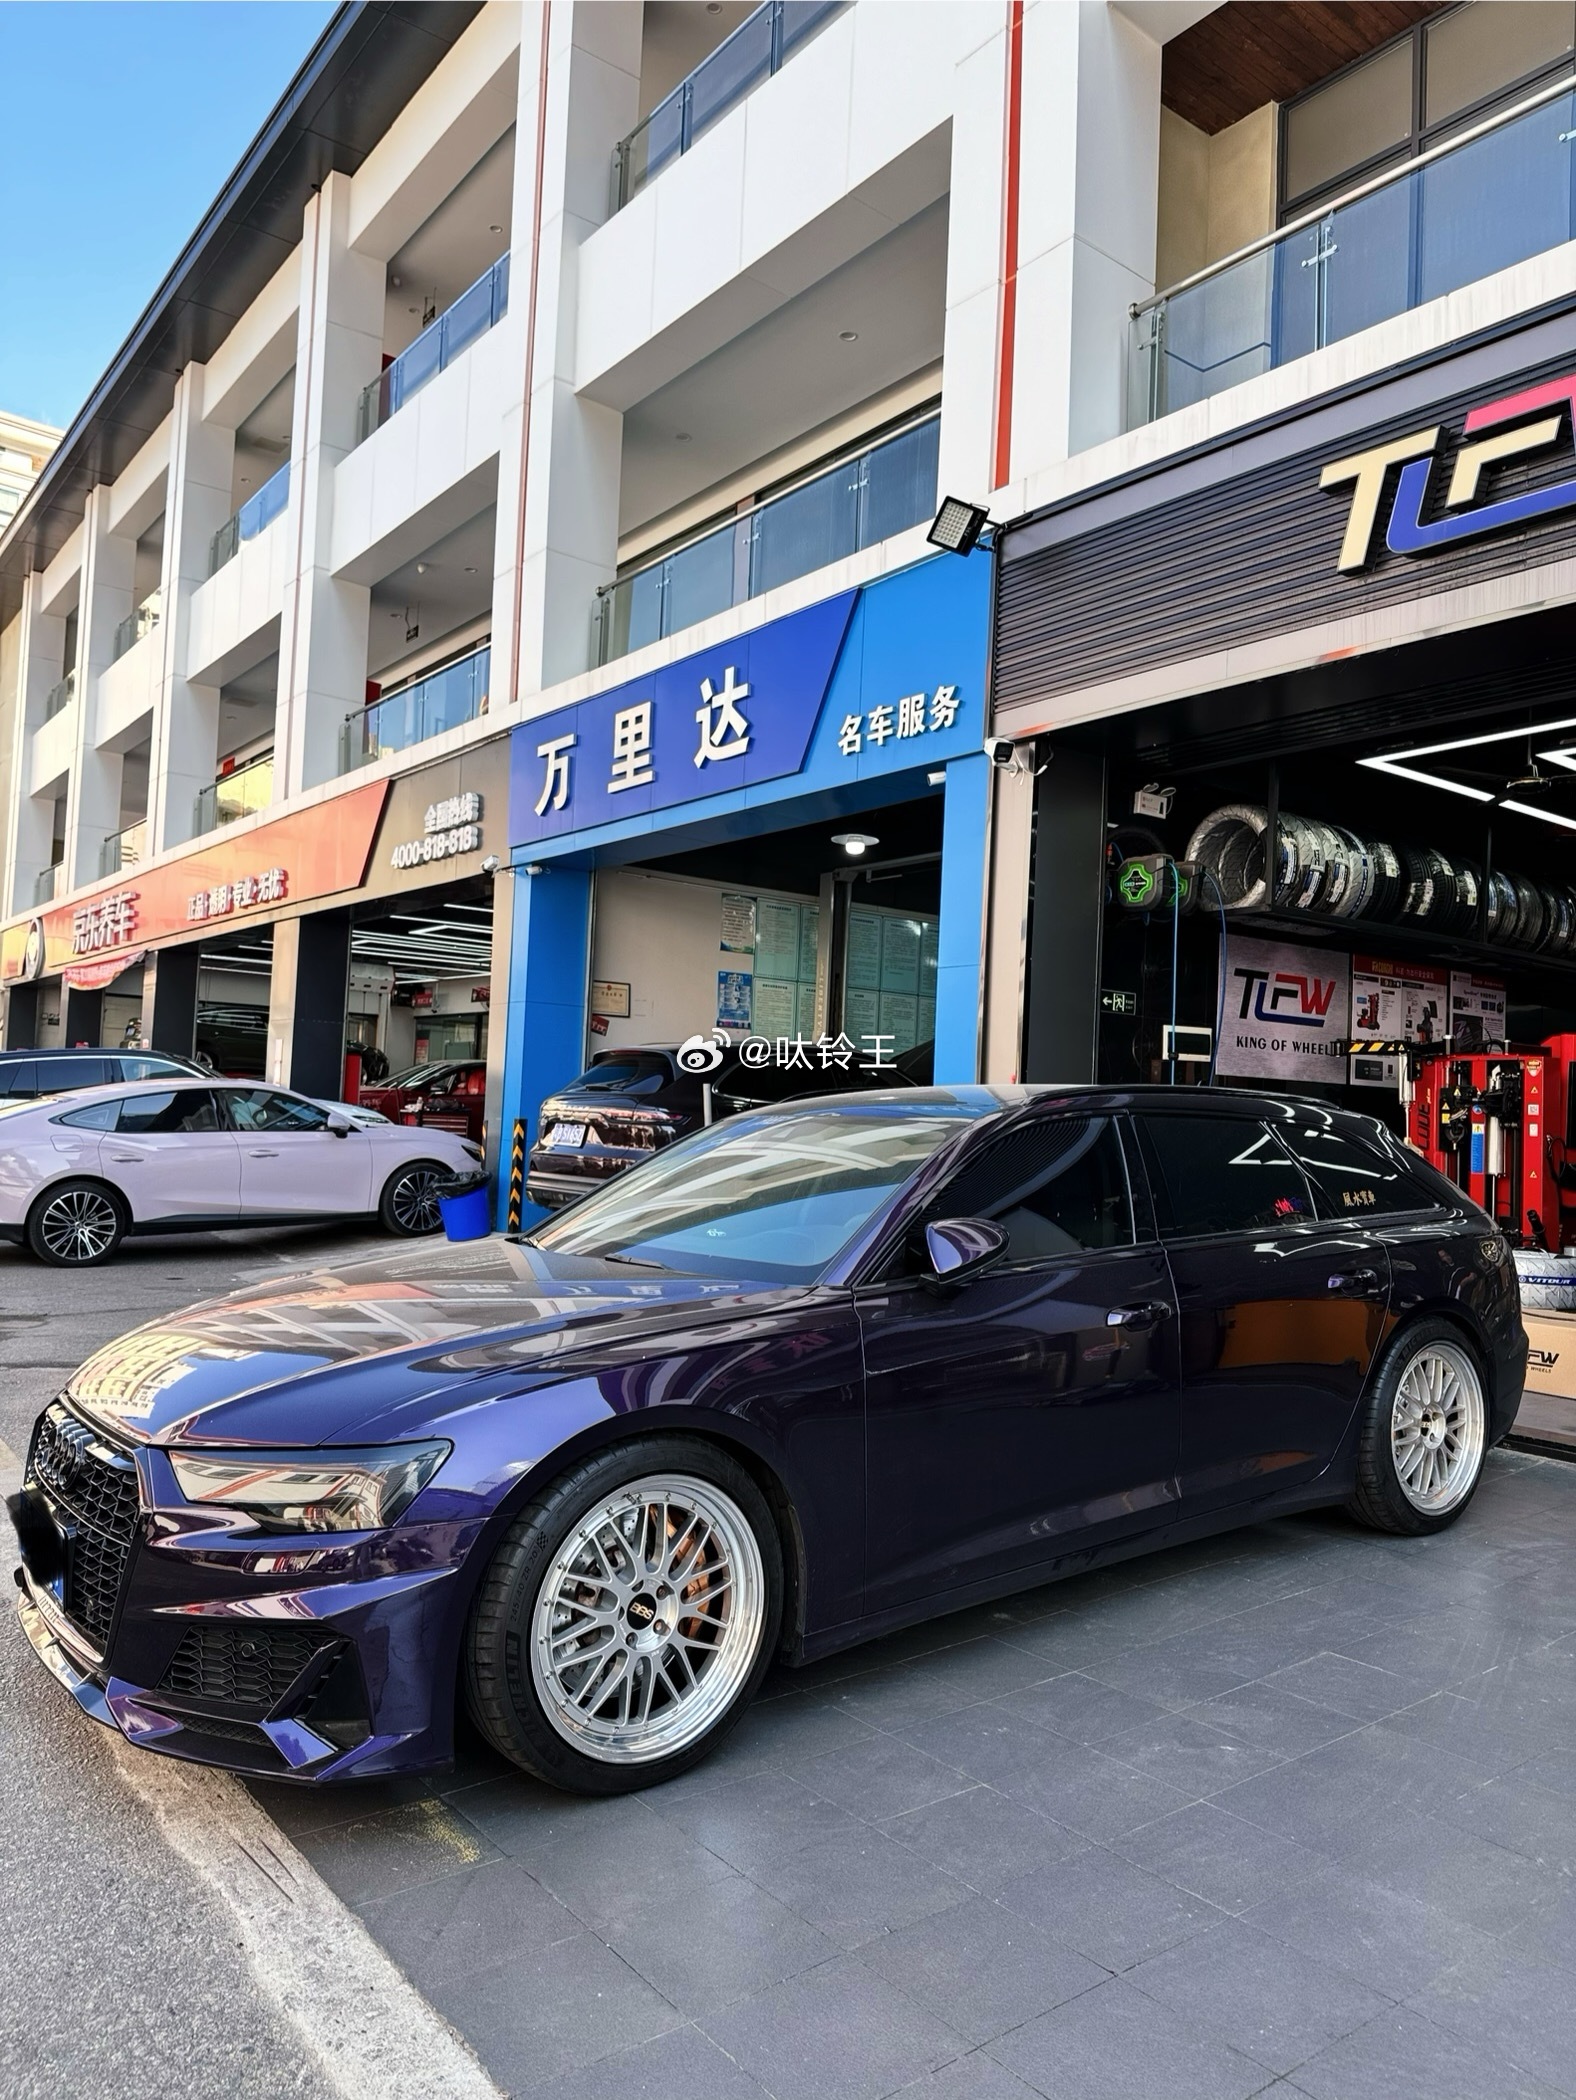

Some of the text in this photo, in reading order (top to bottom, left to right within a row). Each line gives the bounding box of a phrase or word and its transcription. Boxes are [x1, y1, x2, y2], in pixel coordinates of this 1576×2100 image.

[534, 666, 750, 817] 万里达
[838, 685, 960, 756] 名车服务
[424, 792, 477, 834] 全国热线
[390, 825, 477, 869] 4000-818-818
[73, 892, 136, 955] 京东养车
[1236, 1035, 1267, 1050] KING
[1271, 1039, 1287, 1052] OF
[1528, 1277, 1571, 1285] VITOUR
[629, 1602, 654, 1620] BBS
